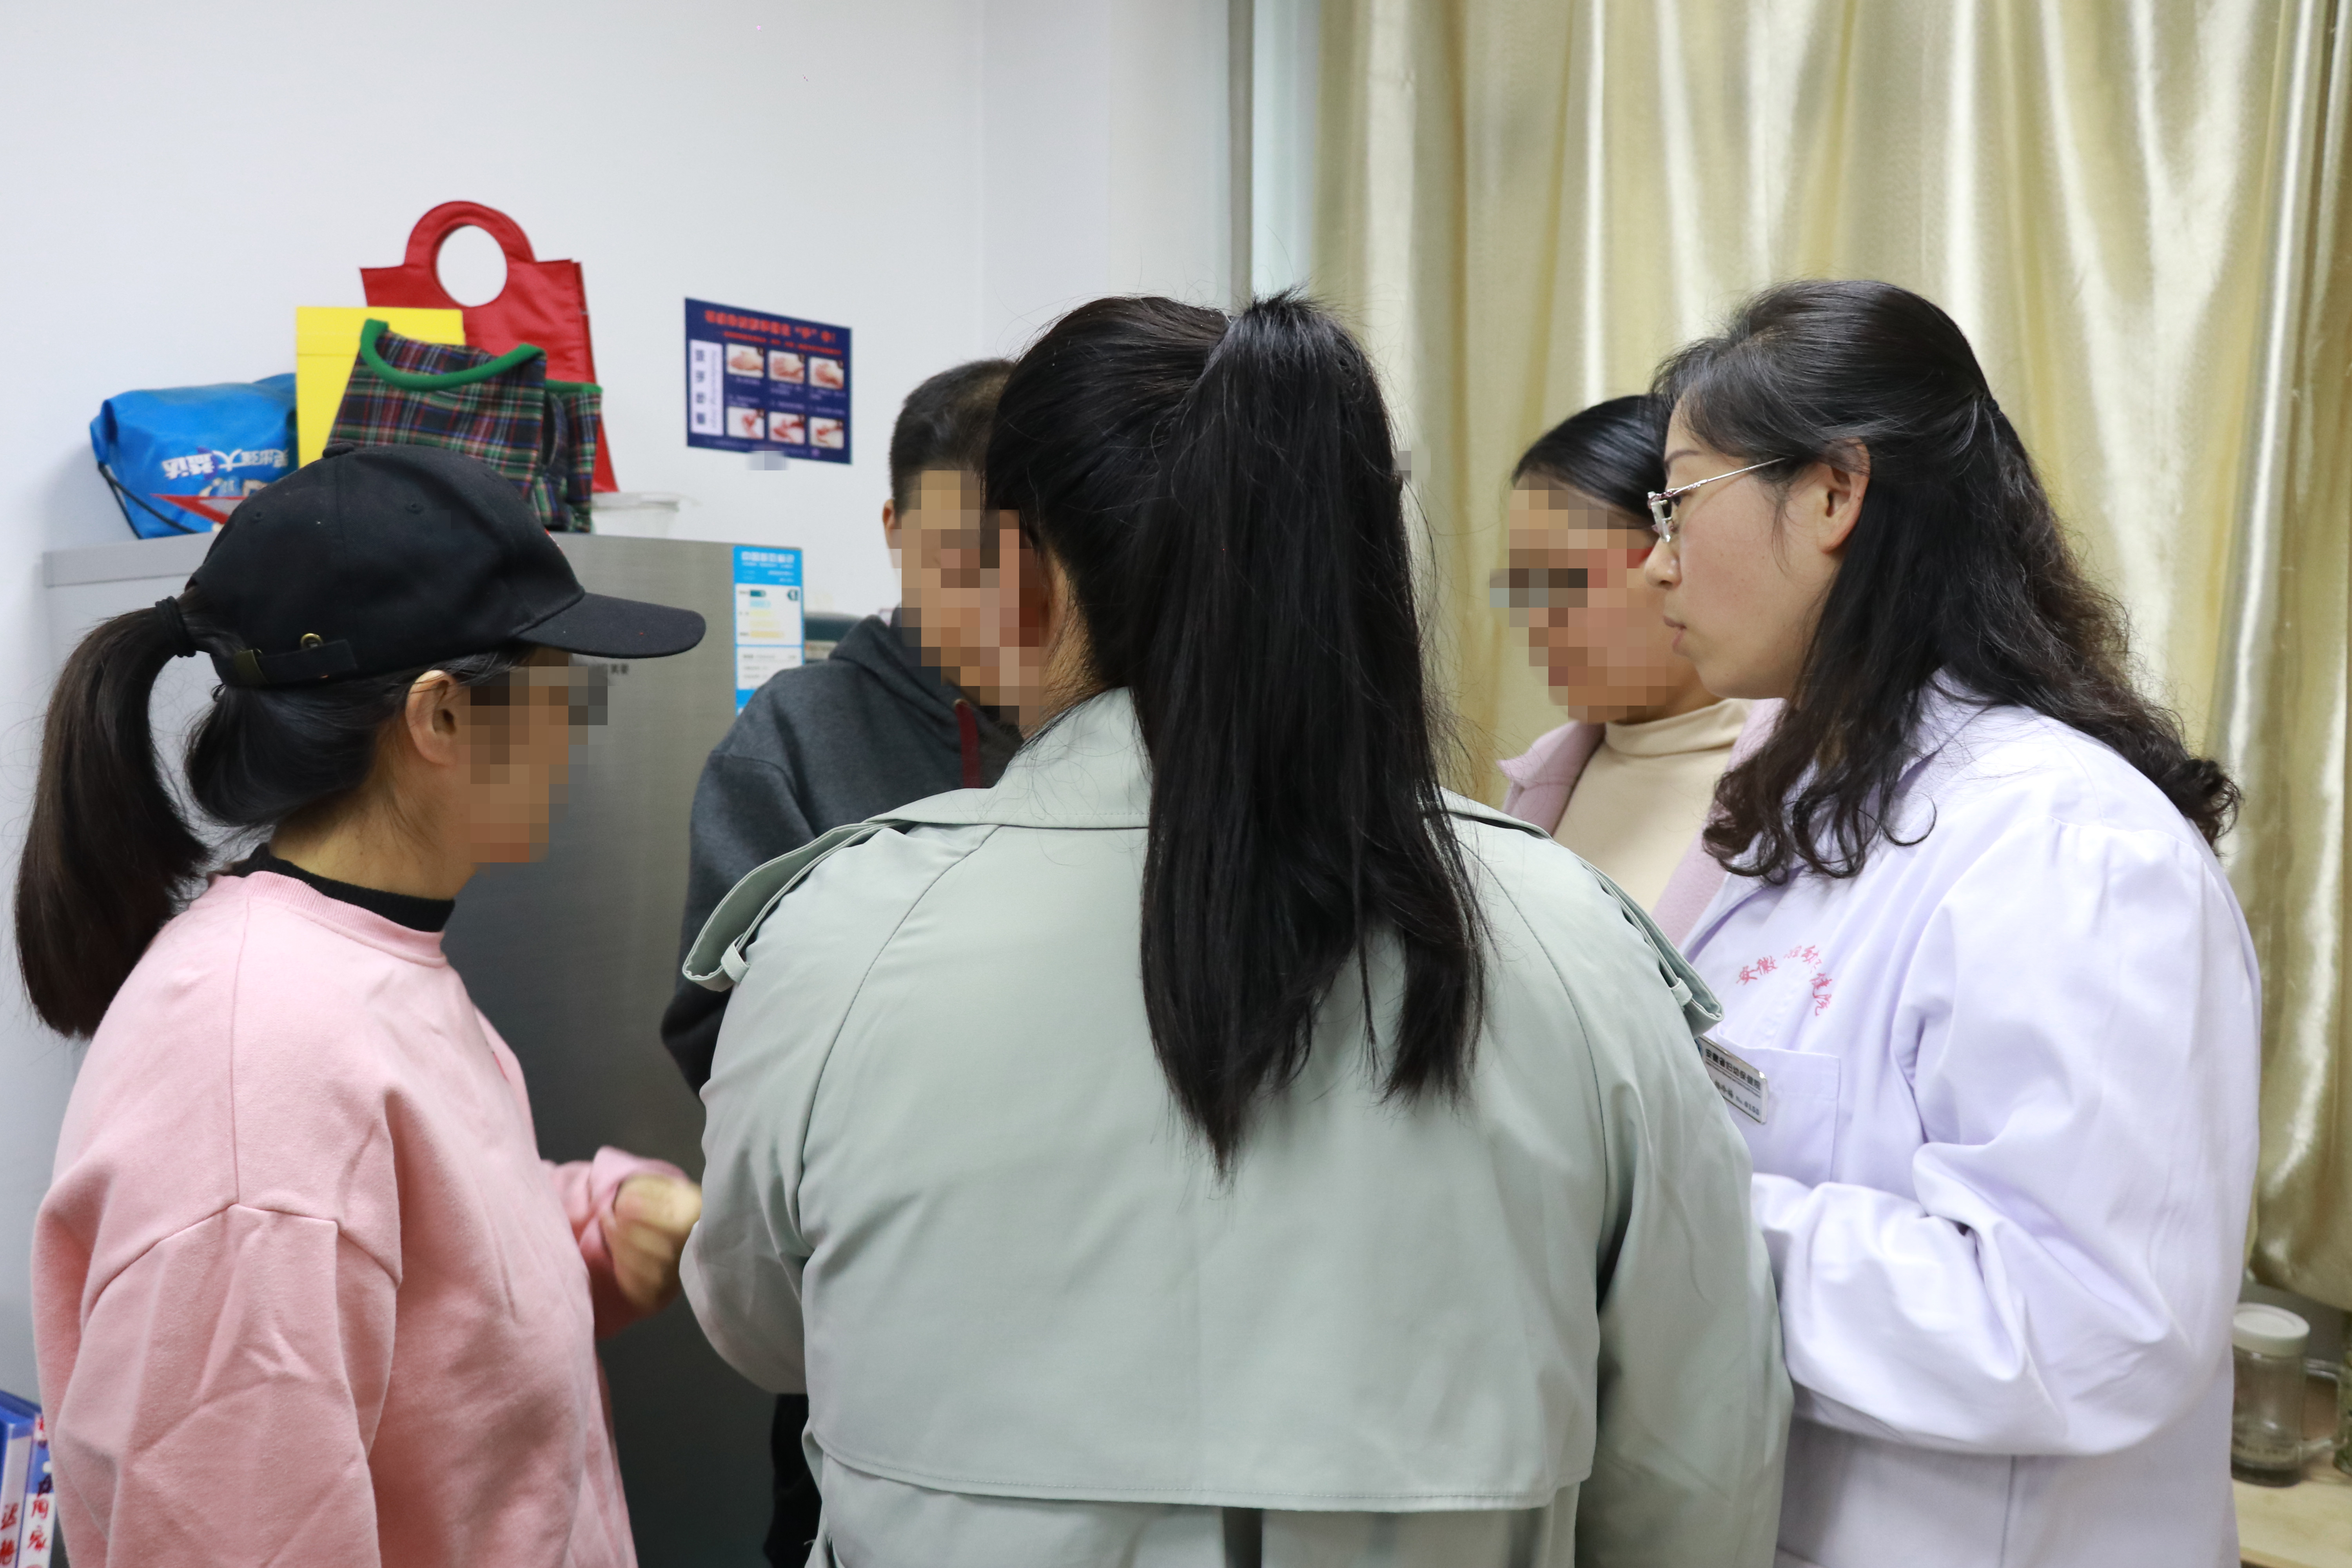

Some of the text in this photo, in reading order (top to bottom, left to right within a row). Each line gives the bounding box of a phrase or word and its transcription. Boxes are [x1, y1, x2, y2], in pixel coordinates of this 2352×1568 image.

[1706, 1049, 1761, 1091] 安徽省妇幼保健院
